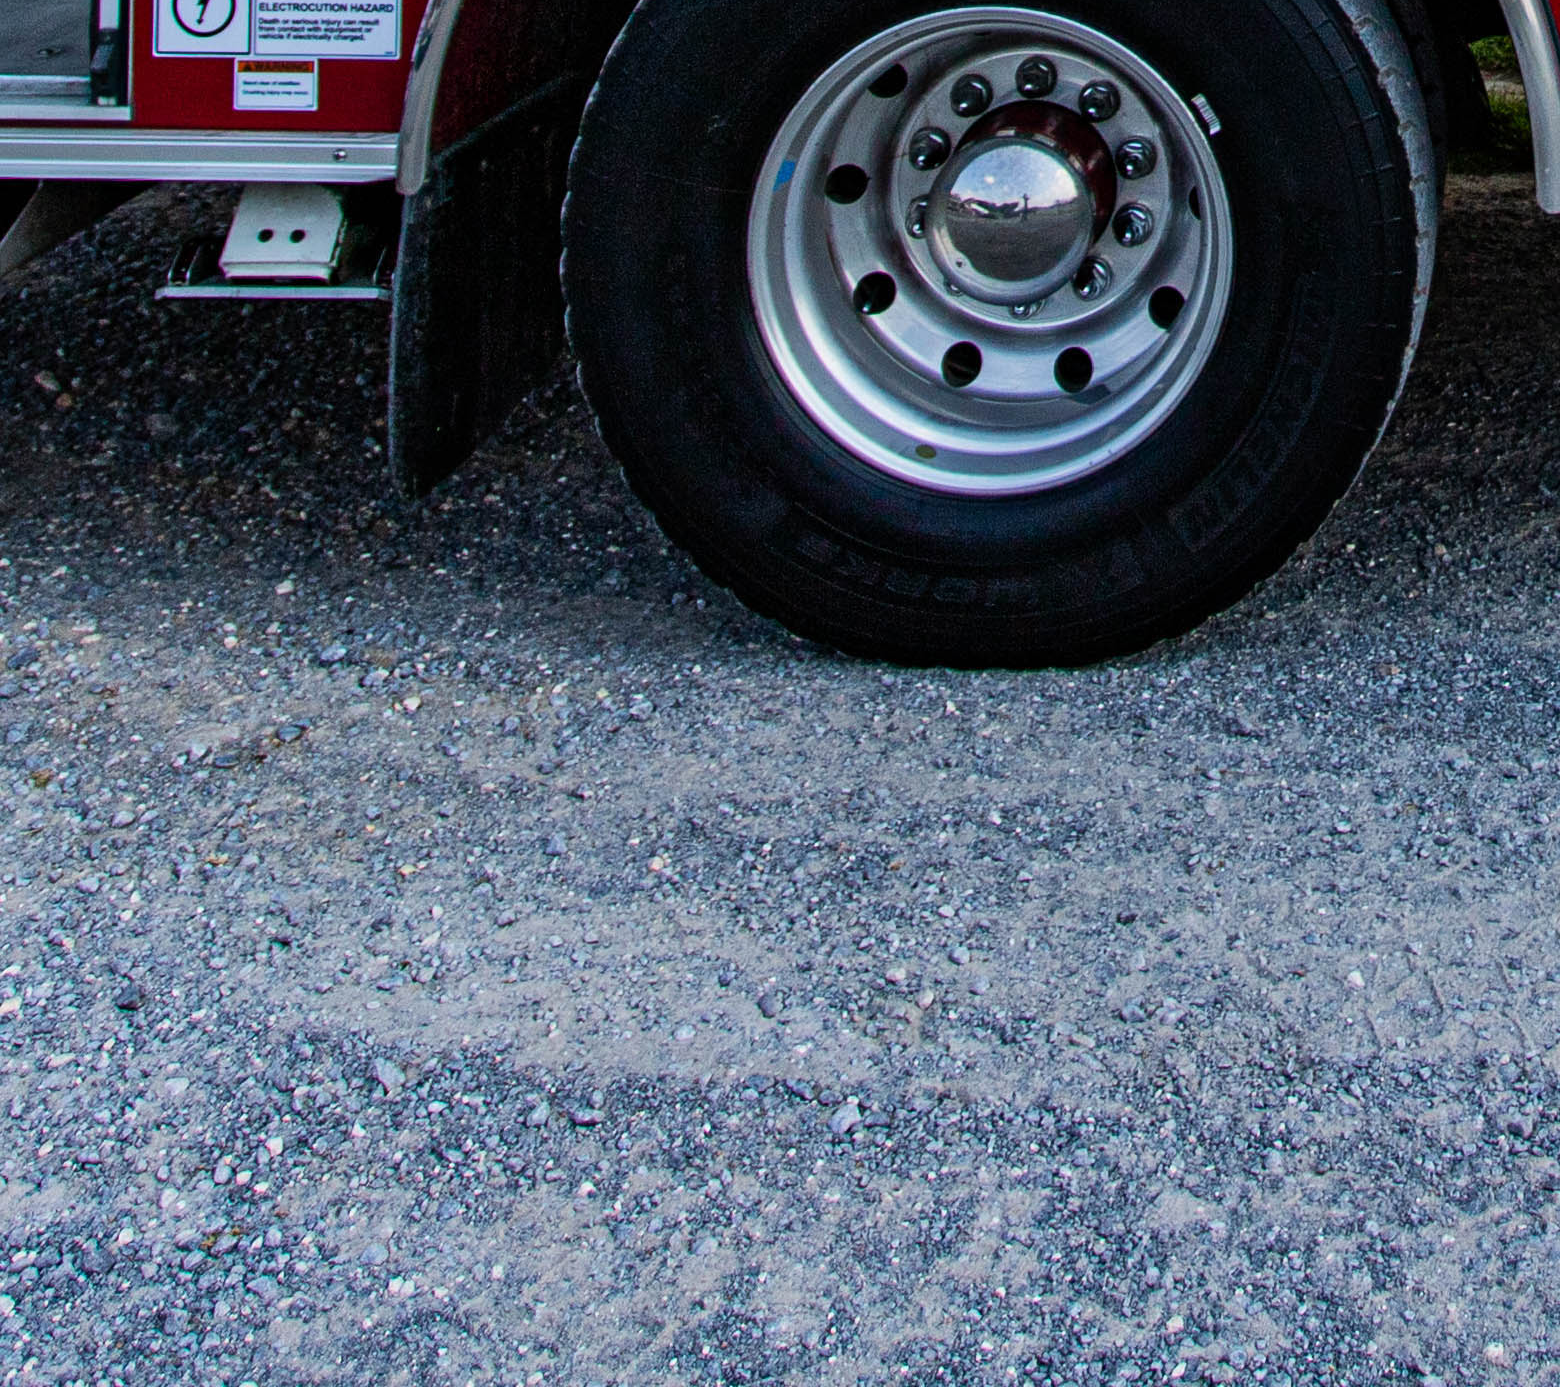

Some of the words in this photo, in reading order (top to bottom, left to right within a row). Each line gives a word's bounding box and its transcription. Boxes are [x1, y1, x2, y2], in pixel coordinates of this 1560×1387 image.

[259, 2, 347, 12] ELECTROCUTION
[350, 3, 394, 13] HAZARD
[321, 19, 341, 27] injury
